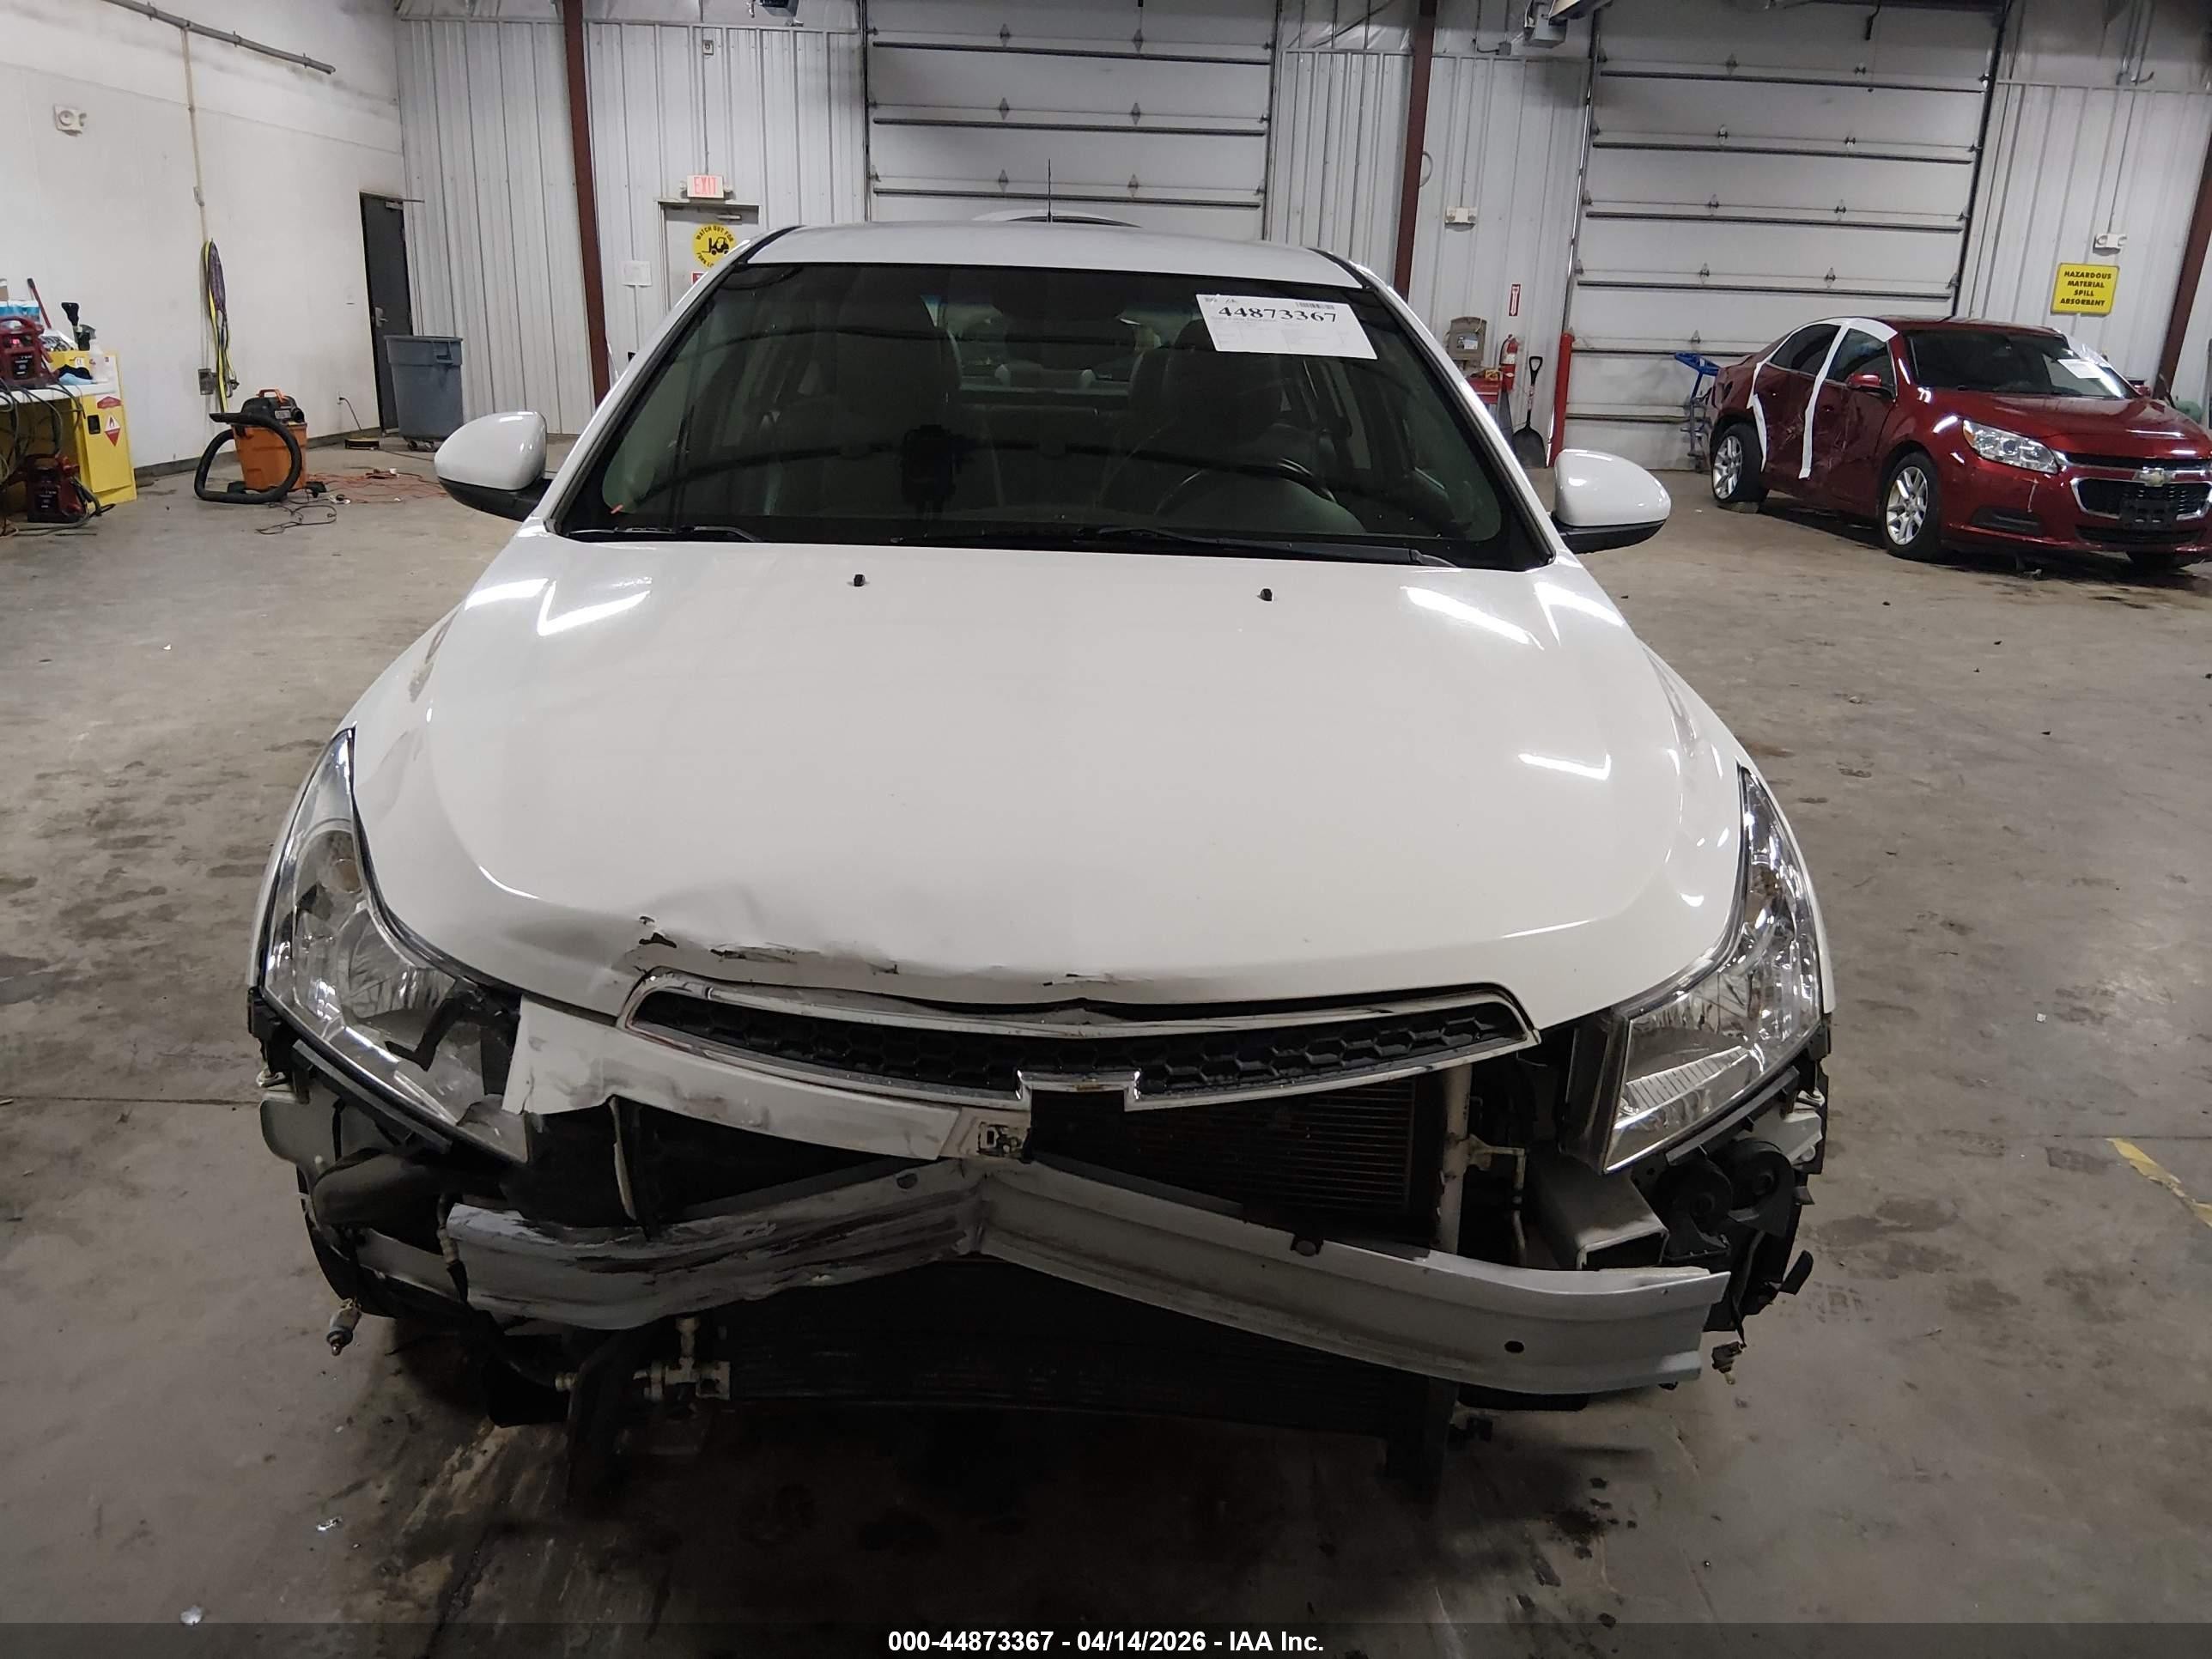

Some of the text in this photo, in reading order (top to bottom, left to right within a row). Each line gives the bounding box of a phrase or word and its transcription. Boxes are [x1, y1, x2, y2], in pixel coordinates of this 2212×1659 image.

[694, 177, 716, 195] EXIT
[696, 226, 712, 240] WATCH
[724, 230, 734, 241] FOR
[2063, 270, 2112, 280] HAZARDOUS
[2067, 280, 2105, 289] MATERIAL
[2060, 298, 2106, 307] ABSORBENT
[1218, 307, 1337, 322] 44873367
